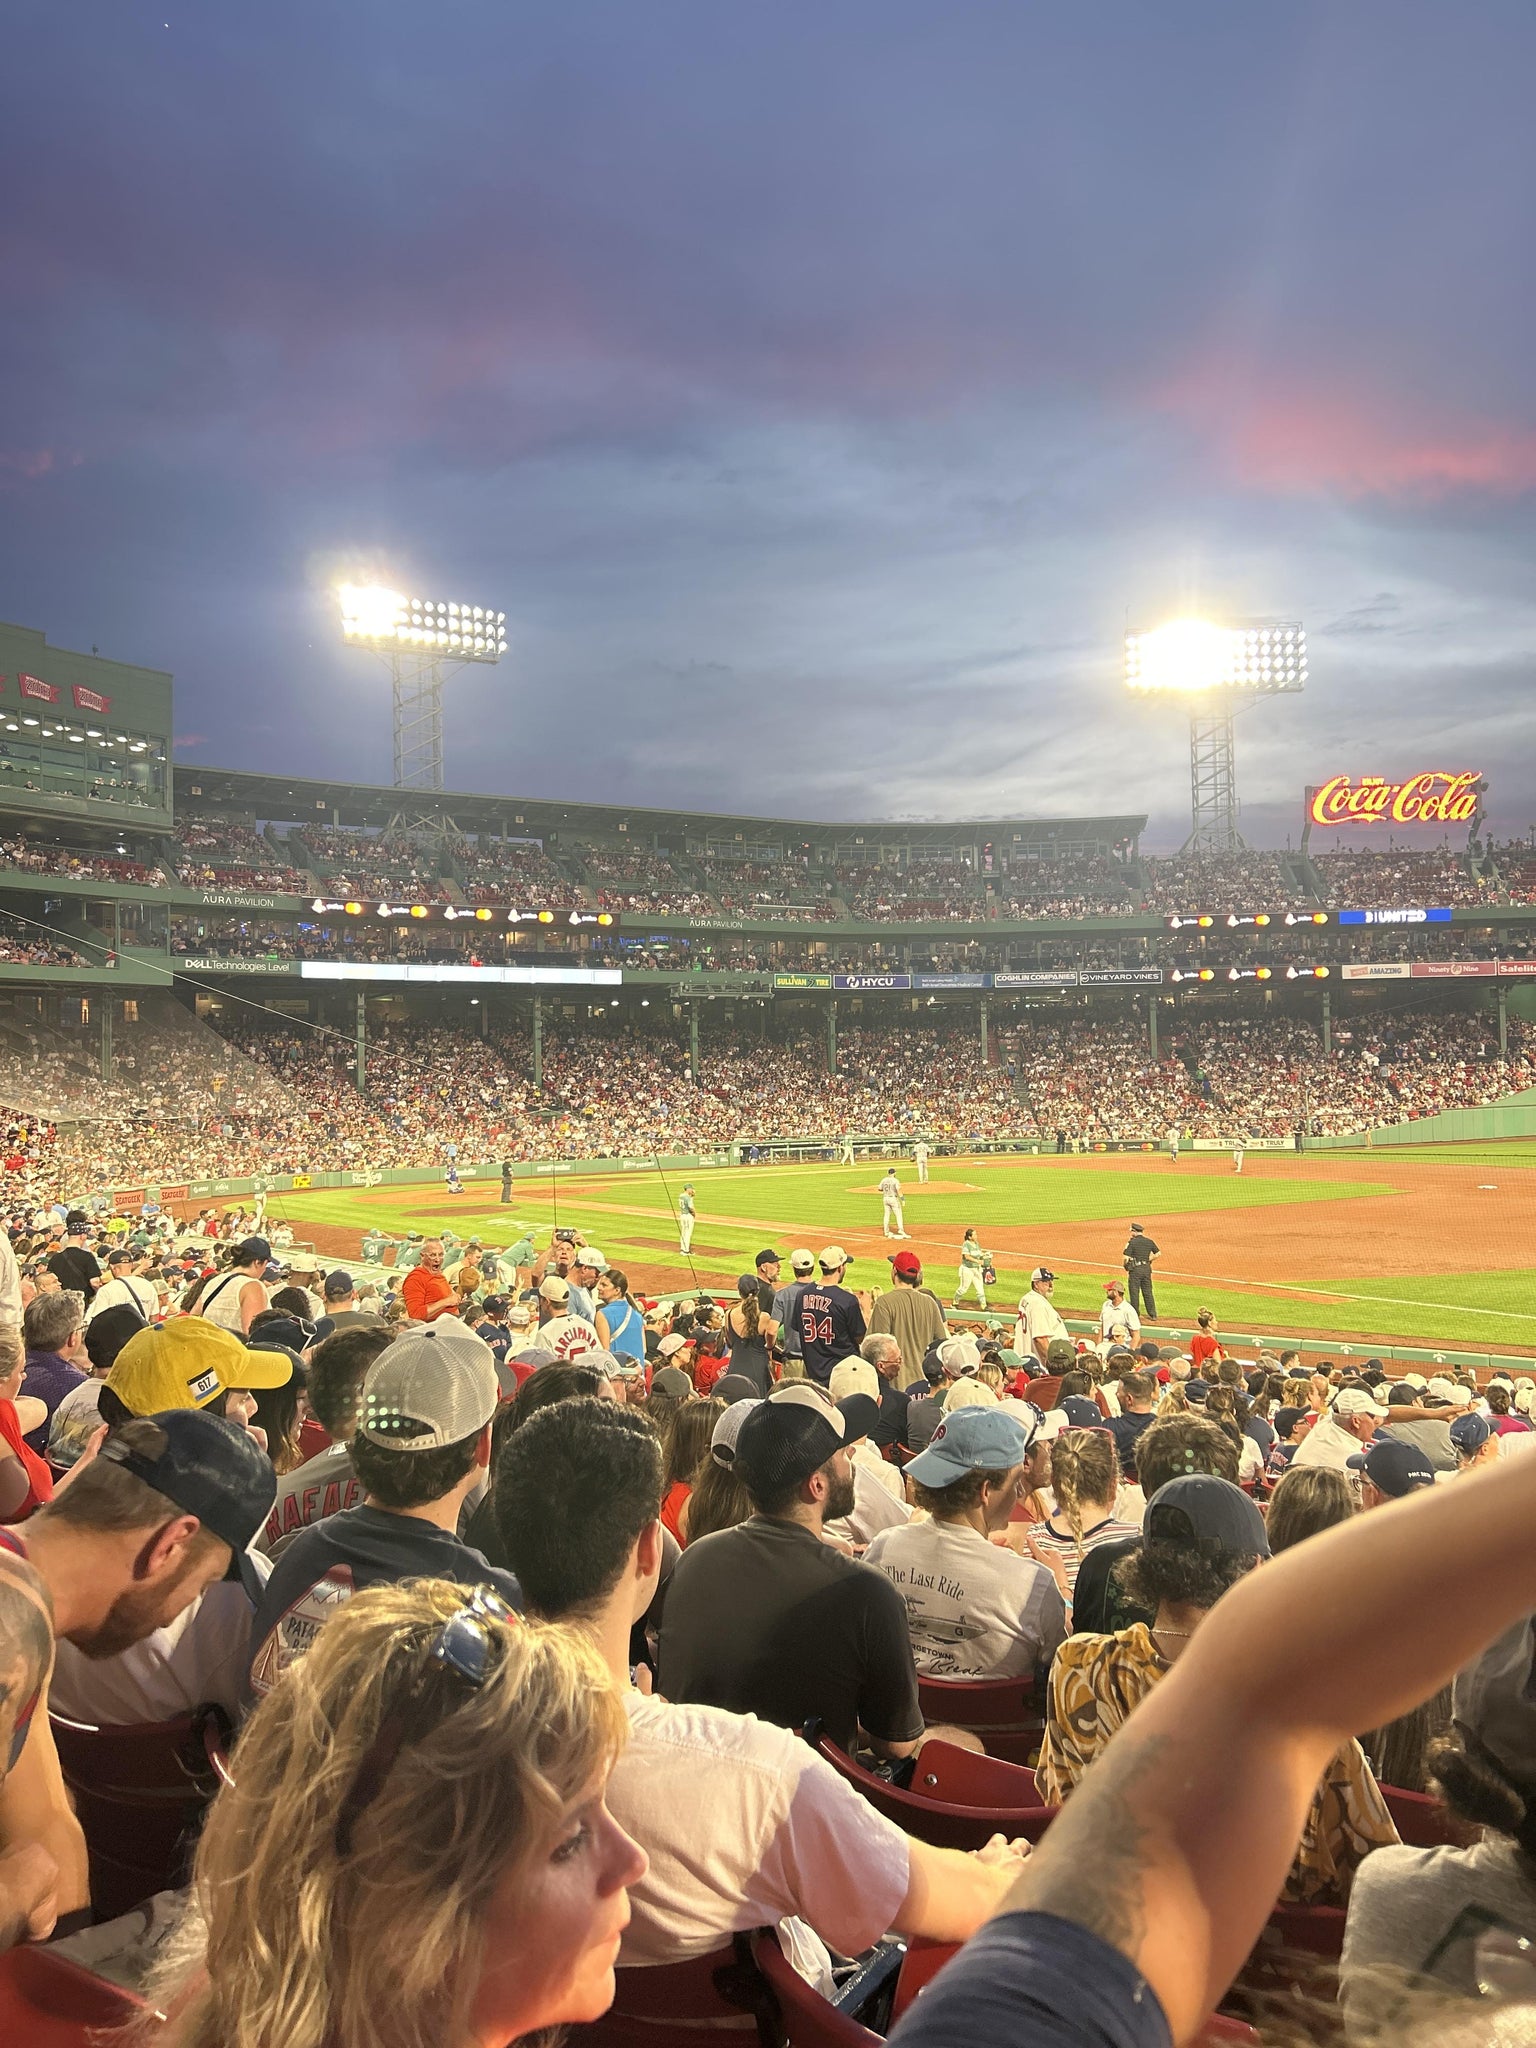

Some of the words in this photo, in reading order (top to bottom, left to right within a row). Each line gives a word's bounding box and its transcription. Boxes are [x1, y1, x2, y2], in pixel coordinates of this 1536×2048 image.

[1312, 771, 1482, 824] Coca-Cola
[234, 897, 274, 907] PAVILION
[1381, 910, 1427, 922] UNITED
[713, 920, 743, 928] PAVILION
[185, 960, 212, 968] DELL
[212, 960, 267, 972] Technologies
[268, 962, 290, 972] Level
[777, 977, 807, 985] SULLIVAN
[815, 978, 829, 986] TIRE
[861, 977, 894, 986] HYCU
[1030, 973, 1076, 981] COMPANIES
[115, 1194, 141, 1205] SEATGEEK
[161, 1189, 186, 1200] SEATGEEK
[802, 1294, 833, 1313] ORTIZ
[801, 1313, 836, 1345] 34
[197, 1377, 212, 1392] 617
[265, 1477, 368, 1545] RAFAE
[885, 1565, 906, 1583] The
[910, 1568, 935, 1589] Last
[938, 1575, 965, 1602] Ride
[954, 1627, 964, 1636] G
[927, 1656, 985, 1677] Break
